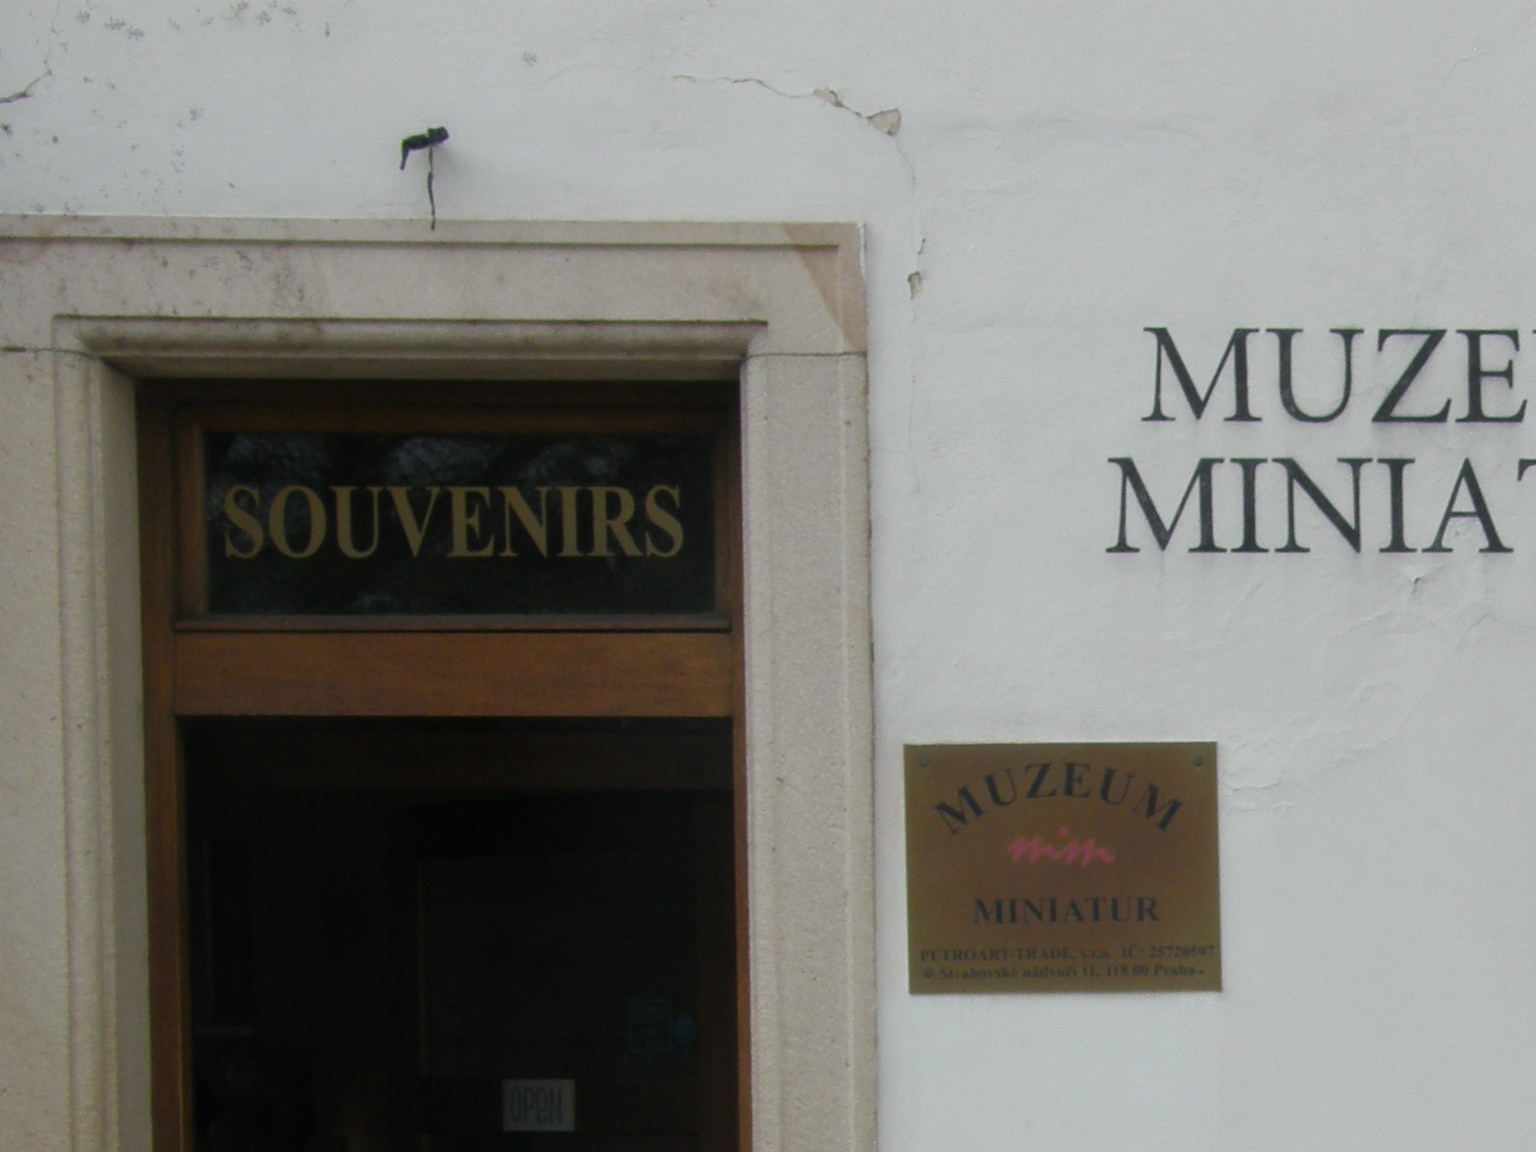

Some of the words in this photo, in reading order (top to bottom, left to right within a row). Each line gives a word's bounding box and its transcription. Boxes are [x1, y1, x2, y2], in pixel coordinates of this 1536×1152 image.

[223, 484, 685, 560] SOUVENIRS
[933, 763, 1182, 835] MUZEUM
[974, 897, 1159, 923] MINIATUR
